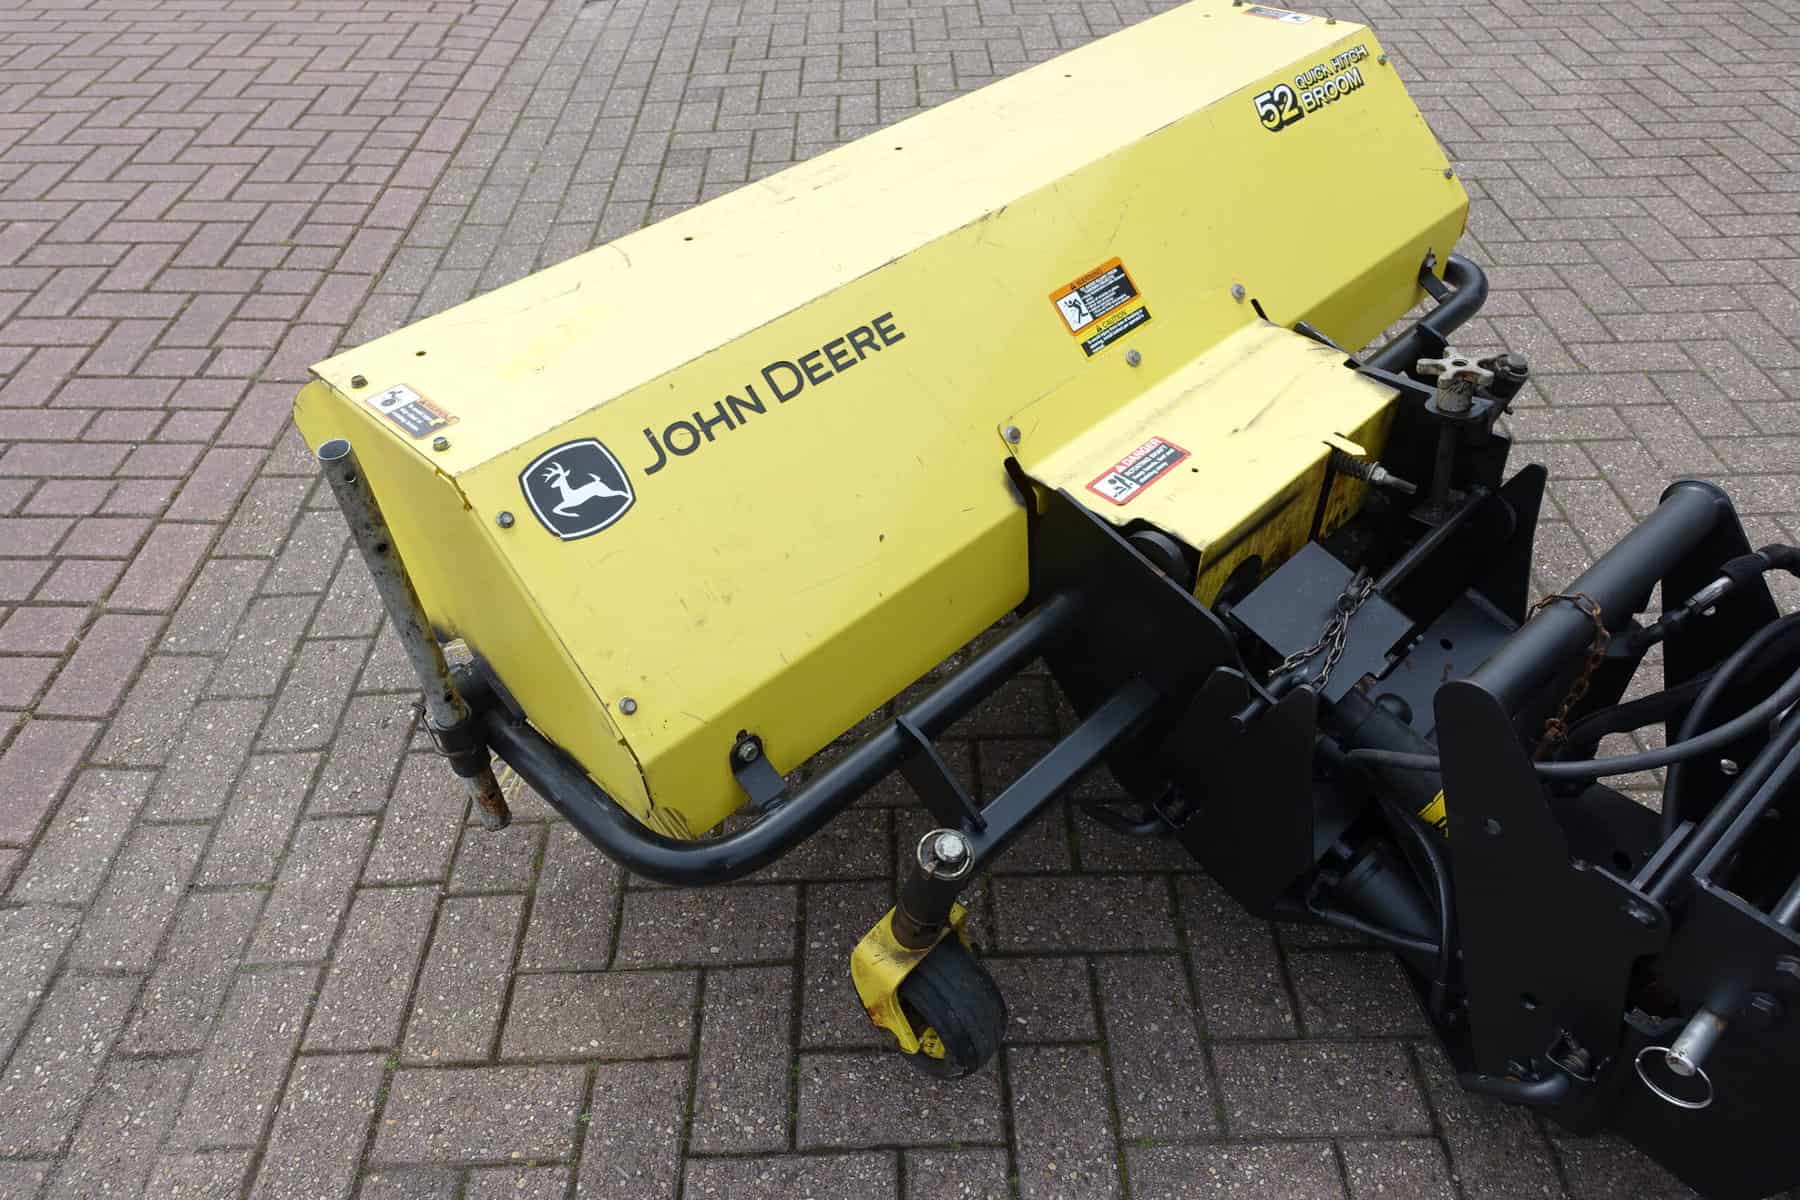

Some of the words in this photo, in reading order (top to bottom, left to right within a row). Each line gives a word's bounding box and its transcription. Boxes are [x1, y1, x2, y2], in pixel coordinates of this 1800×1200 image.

[1294, 63, 1334, 89] QUICK
[1330, 44, 1370, 73] HITCH
[1300, 66, 1365, 113] BROOM
[1253, 83, 1305, 132] 52
[1102, 310, 1127, 328] CAUTION
[643, 384, 767, 476] JOHN
[760, 312, 906, 403] DEERE
[1120, 438, 1163, 466] DANGER
